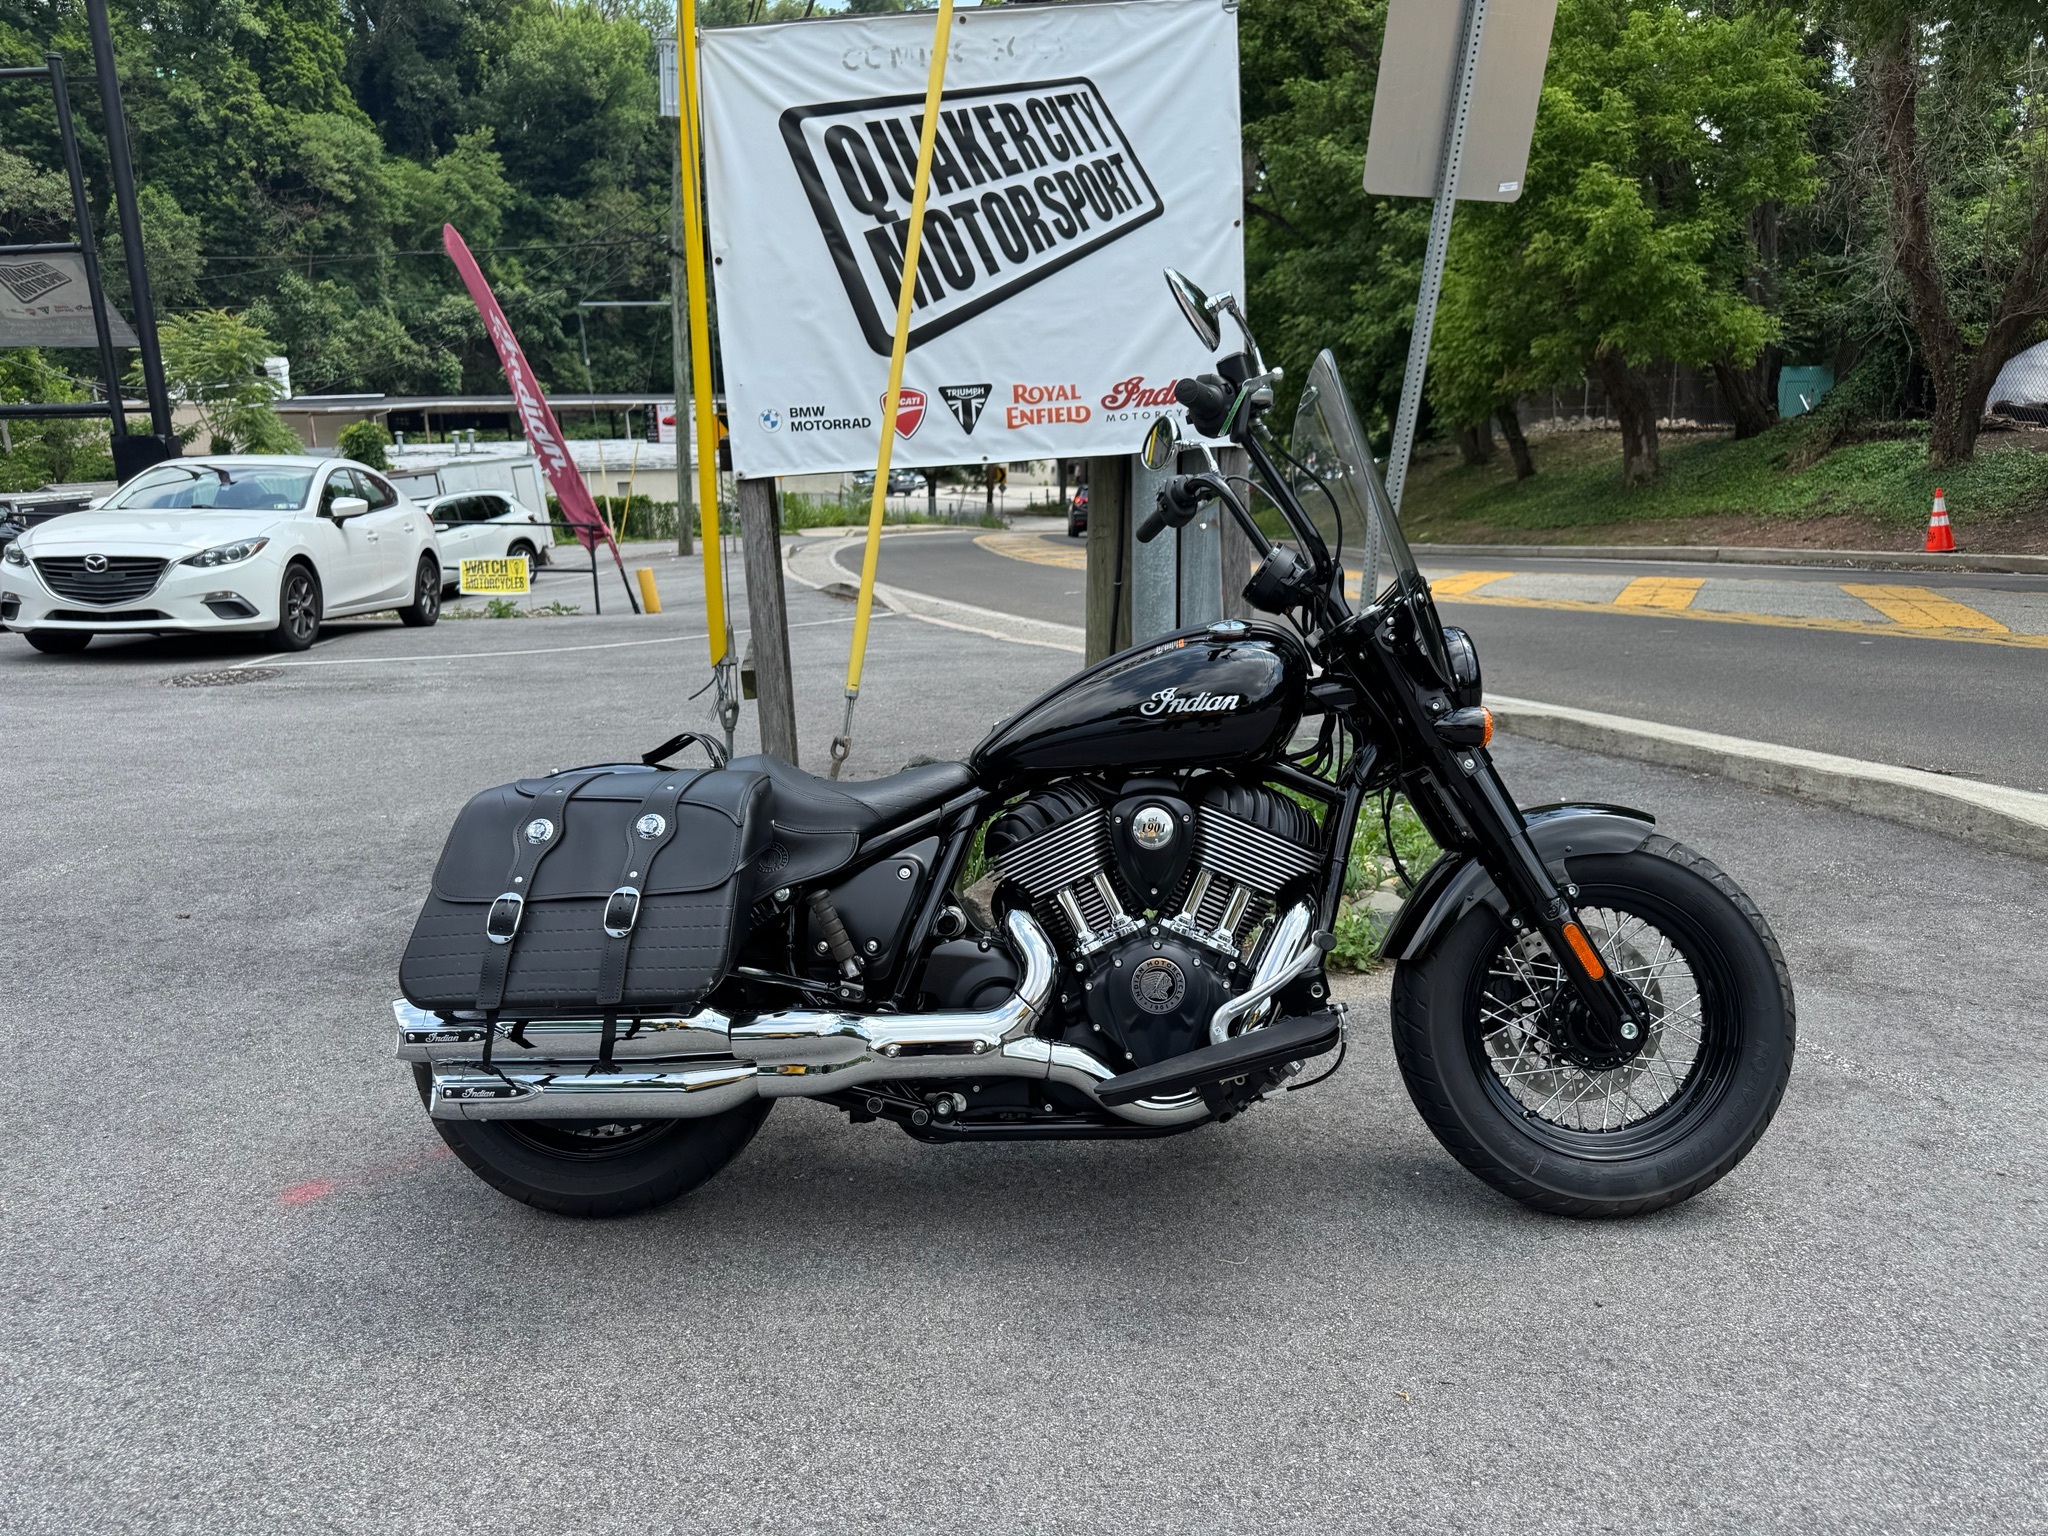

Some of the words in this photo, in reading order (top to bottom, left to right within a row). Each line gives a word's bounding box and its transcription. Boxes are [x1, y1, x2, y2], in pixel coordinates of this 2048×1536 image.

[824, 103, 1048, 225] QUAKER
[1026, 91, 1112, 162] CITY
[863, 153, 1143, 315] MOTORSPORT
[946, 387, 985, 397] TRIUMPH
[1012, 384, 1082, 405] ROYAL
[1101, 376, 1181, 411] Ind
[899, 396, 921, 405] CATI
[789, 406, 826, 418] BMW
[1006, 405, 1091, 429] ENFIELD
[1106, 408, 1189, 423] MOTORCY
[790, 417, 872, 432] MOTORRAD
[464, 560, 508, 574] WATCH
[465, 576, 525, 589] MOTORCYCLES
[1140, 687, 1240, 716] Indian
[1142, 823, 1166, 833] 1901
[1133, 967, 1145, 1000] INDIAN
[1146, 960, 1184, 1001] MOTORCYCLE
[425, 1032, 460, 1043] Indian
[461, 1087, 496, 1098] Indian
